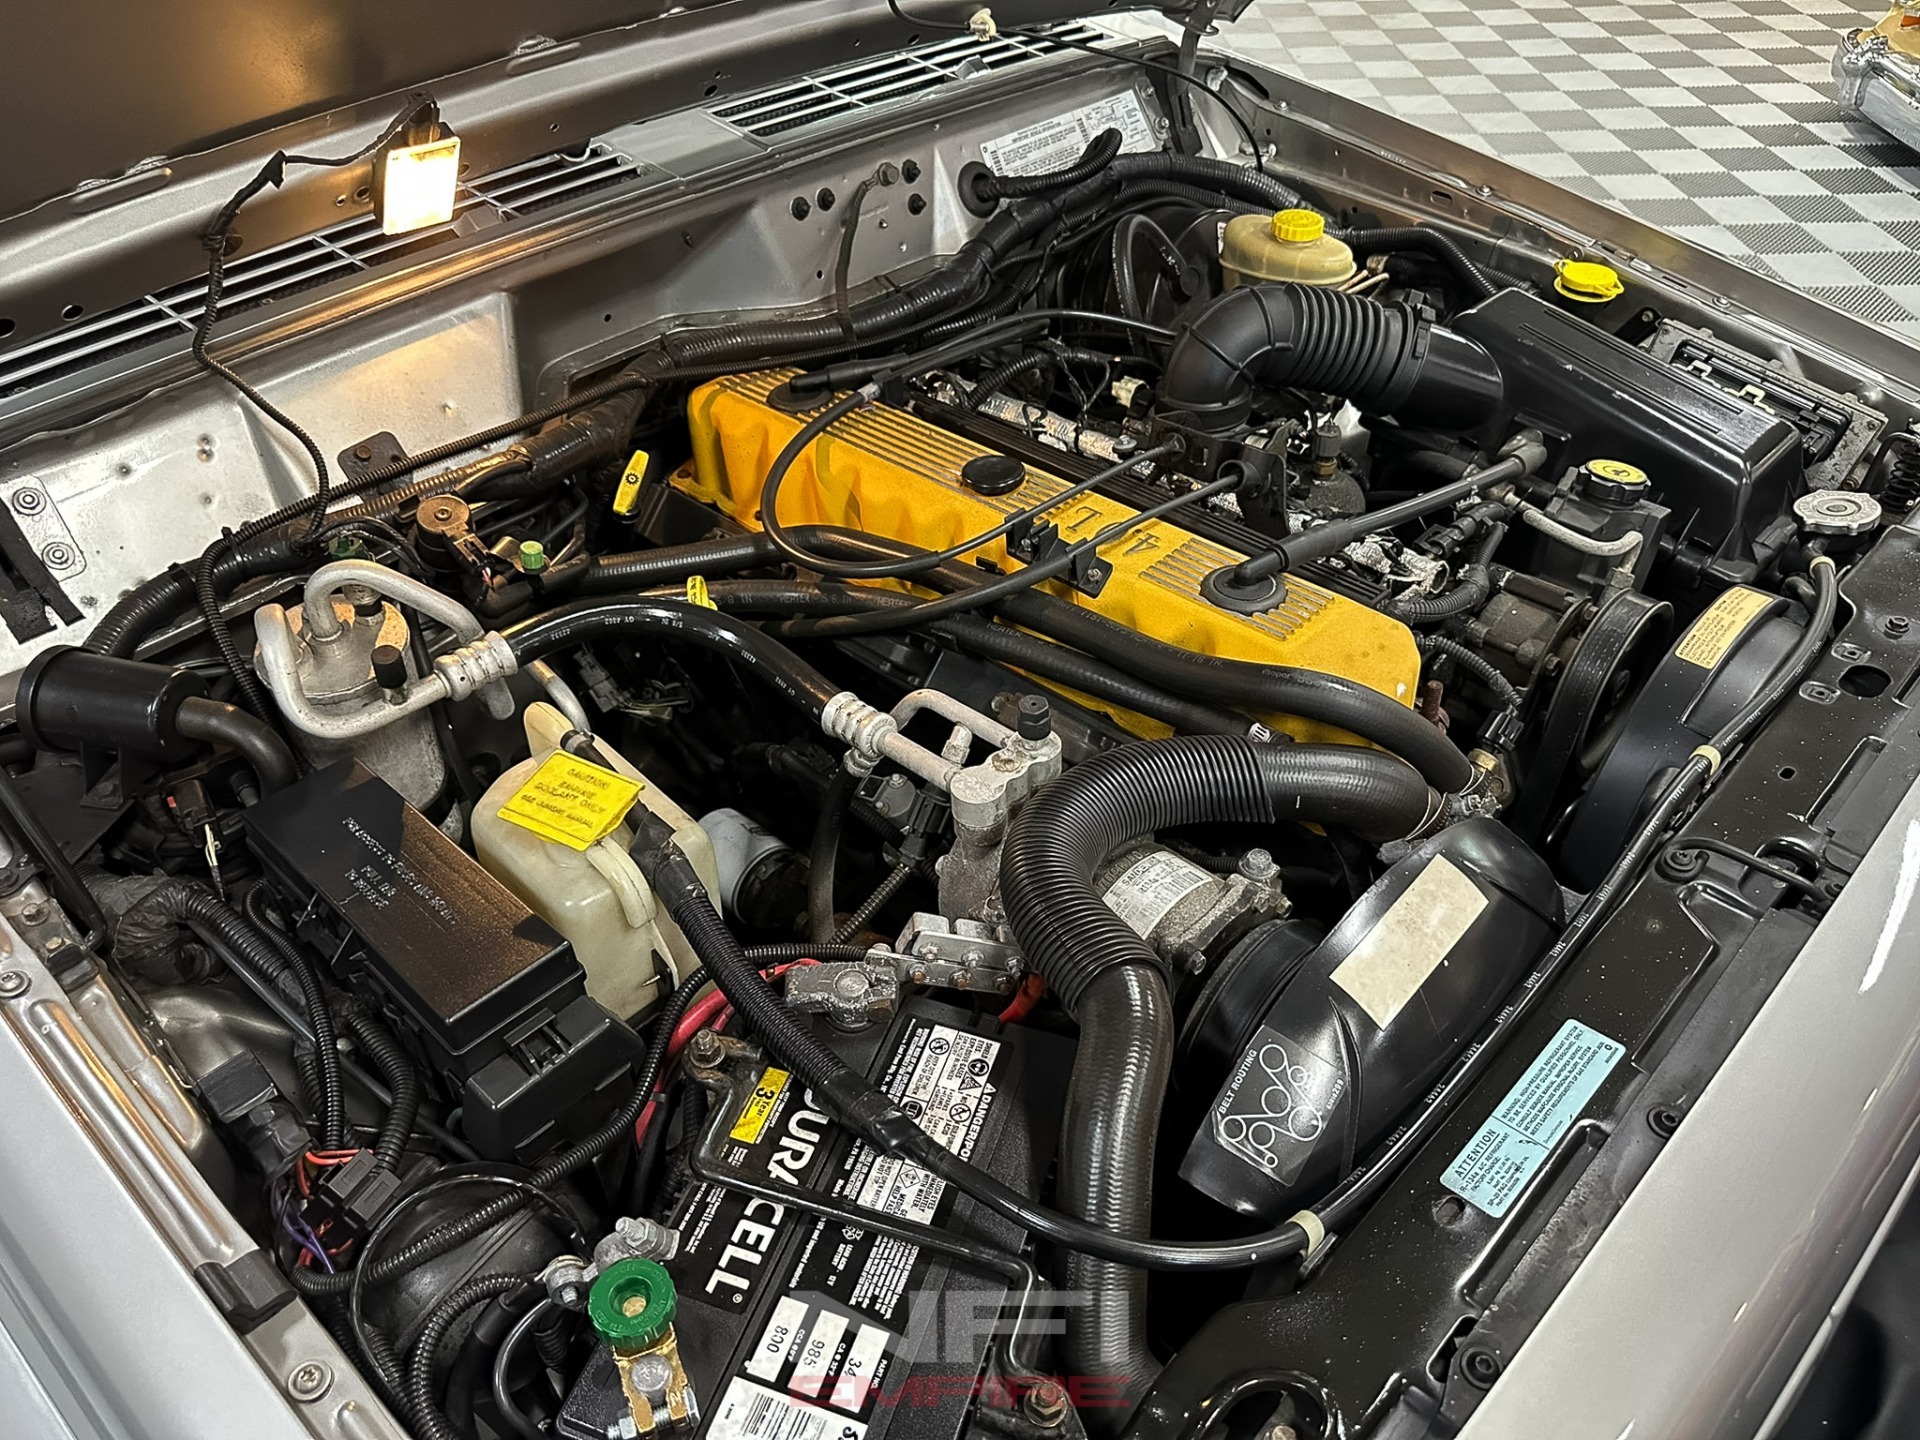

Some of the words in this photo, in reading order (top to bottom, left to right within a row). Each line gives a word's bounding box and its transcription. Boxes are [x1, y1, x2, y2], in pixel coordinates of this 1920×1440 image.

[960, 1034, 970, 1045] CAN
[955, 1043, 966, 1059] CAUSE
[960, 1036, 977, 1063] EXPLOSIVE
[979, 1040, 993, 1060] SHIELD
[923, 1052, 933, 1067] REACH
[929, 1054, 940, 1067] KEEP
[1517, 1065, 1547, 1097] HIGH-PRESSURE
[1542, 1039, 1567, 1067] REFRIGERANT
[1562, 1024, 1579, 1041] SYSTEM
[1580, 1048, 1599, 1069] STANDARD
[920, 1065, 928, 1074] OF
[925, 1065, 935, 1076] OUT
[945, 1056, 960, 1081] BLINDNESS
[953, 1060, 967, 1079] GASES
[1574, 1066, 1585, 1076] SAE
[919, 1079, 929, 1090] THE
[923, 1073, 932, 1082] OF
[1217, 1088, 1236, 1115] BELT
[1228, 1047, 1260, 1091] ROUTING
[1506, 1115, 1516, 1123] TO
[1512, 1108, 1521, 1116] BE
[1517, 1088, 1537, 1110] SERVICED
[1533, 1082, 1542, 1090] BY
[1538, 1061, 1559, 1083] QUALIFIED
[1554, 1039, 1577, 1063] PERSONNEL
[1514, 1108, 1533, 1128] CONSULT
[1528, 1093, 1545, 1111] SERVICE
[1553, 1058, 1572, 1079] IMPROPER
[1567, 1044, 1583, 1061] SERVICE
[1570, 1074, 1579, 1082] OF
[753, 1084, 776, 1103] 3
[1521, 1112, 1540, 1132] METHODS
[1551, 1072, 1570, 1093] PERSONAL
[1576, 1045, 1592, 1061] SYSTEM
[1549, 1079, 1575, 1109] REQUIREMENTS
[754, 1098, 770, 1119] Year
[1538, 1106, 1554, 1123] SAFETY
[940, 1121, 951, 1136] ACID
[1528, 1121, 1543, 1136] MEETS
[850, 1146, 859, 1156] PA
[1452, 1127, 1497, 1178] ATTENTION
[875, 1162, 885, 1175] NOT
[882, 1163, 892, 1176] NOT
[1458, 1169, 1480, 1193] R-134a
[1476, 1160, 1488, 1171] A/C
[1483, 1131, 1510, 1162] REFRIGERANT
[876, 1174, 888, 1190] OPEN
[918, 1172, 931, 1188] WITH
[1469, 1172, 1487, 1192] FACTORY
[1496, 1181, 1508, 1194] PAG
[889, 1184, 902, 1200] HELP
[917, 1175, 938, 1213] IMMEDIATELY
[925, 1194, 938, 1211] EYES
[814, 1219, 825, 1231] US
[809, 1228, 821, 1241] and
[798, 1237, 817, 1264] imported
[829, 1241, 846, 1267] BATTERY
[841, 1242, 854, 1258] LEAD
[835, 1255, 848, 1272] ACID
[786, 1260, 806, 1290] materials
[764, 1323, 789, 1355] 800
[792, 1327, 806, 1344] CCA
[800, 1336, 826, 1370] 985
[836, 1341, 847, 1354] CA
[842, 1356, 863, 1379] 34
[874, 1357, 887, 1377] PART
[868, 1375, 880, 1391] NO.
